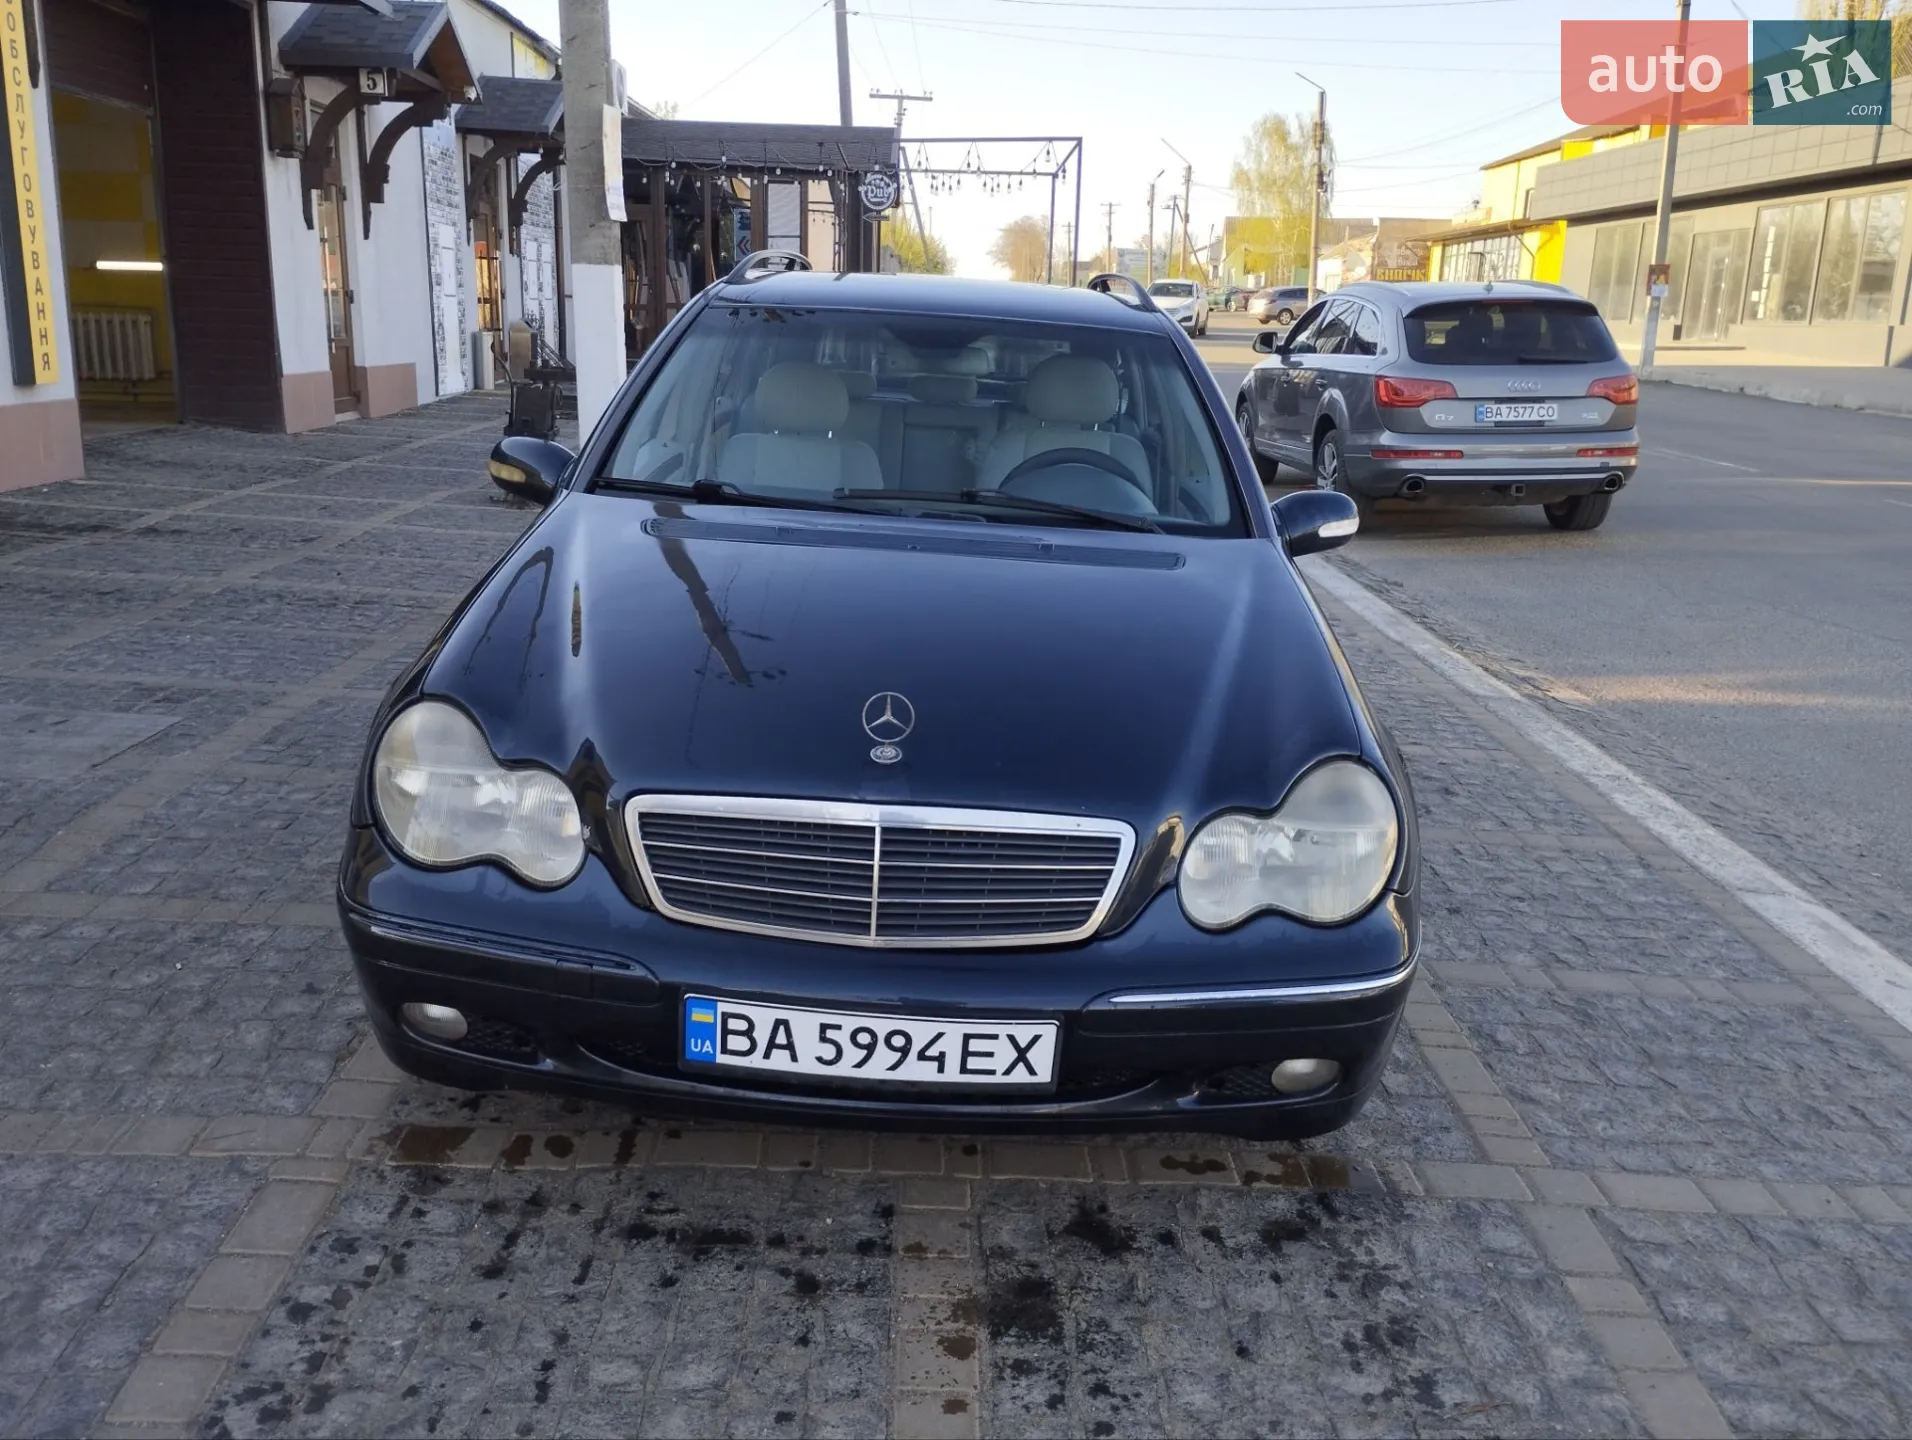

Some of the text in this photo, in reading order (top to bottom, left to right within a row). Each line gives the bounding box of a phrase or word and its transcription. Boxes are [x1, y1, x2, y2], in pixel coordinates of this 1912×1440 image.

[366, 71, 377, 91] 5
[6, 0, 51, 371] ОБСЛУГОВУВАННЯ
[1376, 268, 1425, 281] ВИПІЧК
[1485, 405, 1555, 419] BA 7577 CO
[690, 1038, 714, 1055] UA
[720, 1011, 1043, 1077] BA 5994 EX
